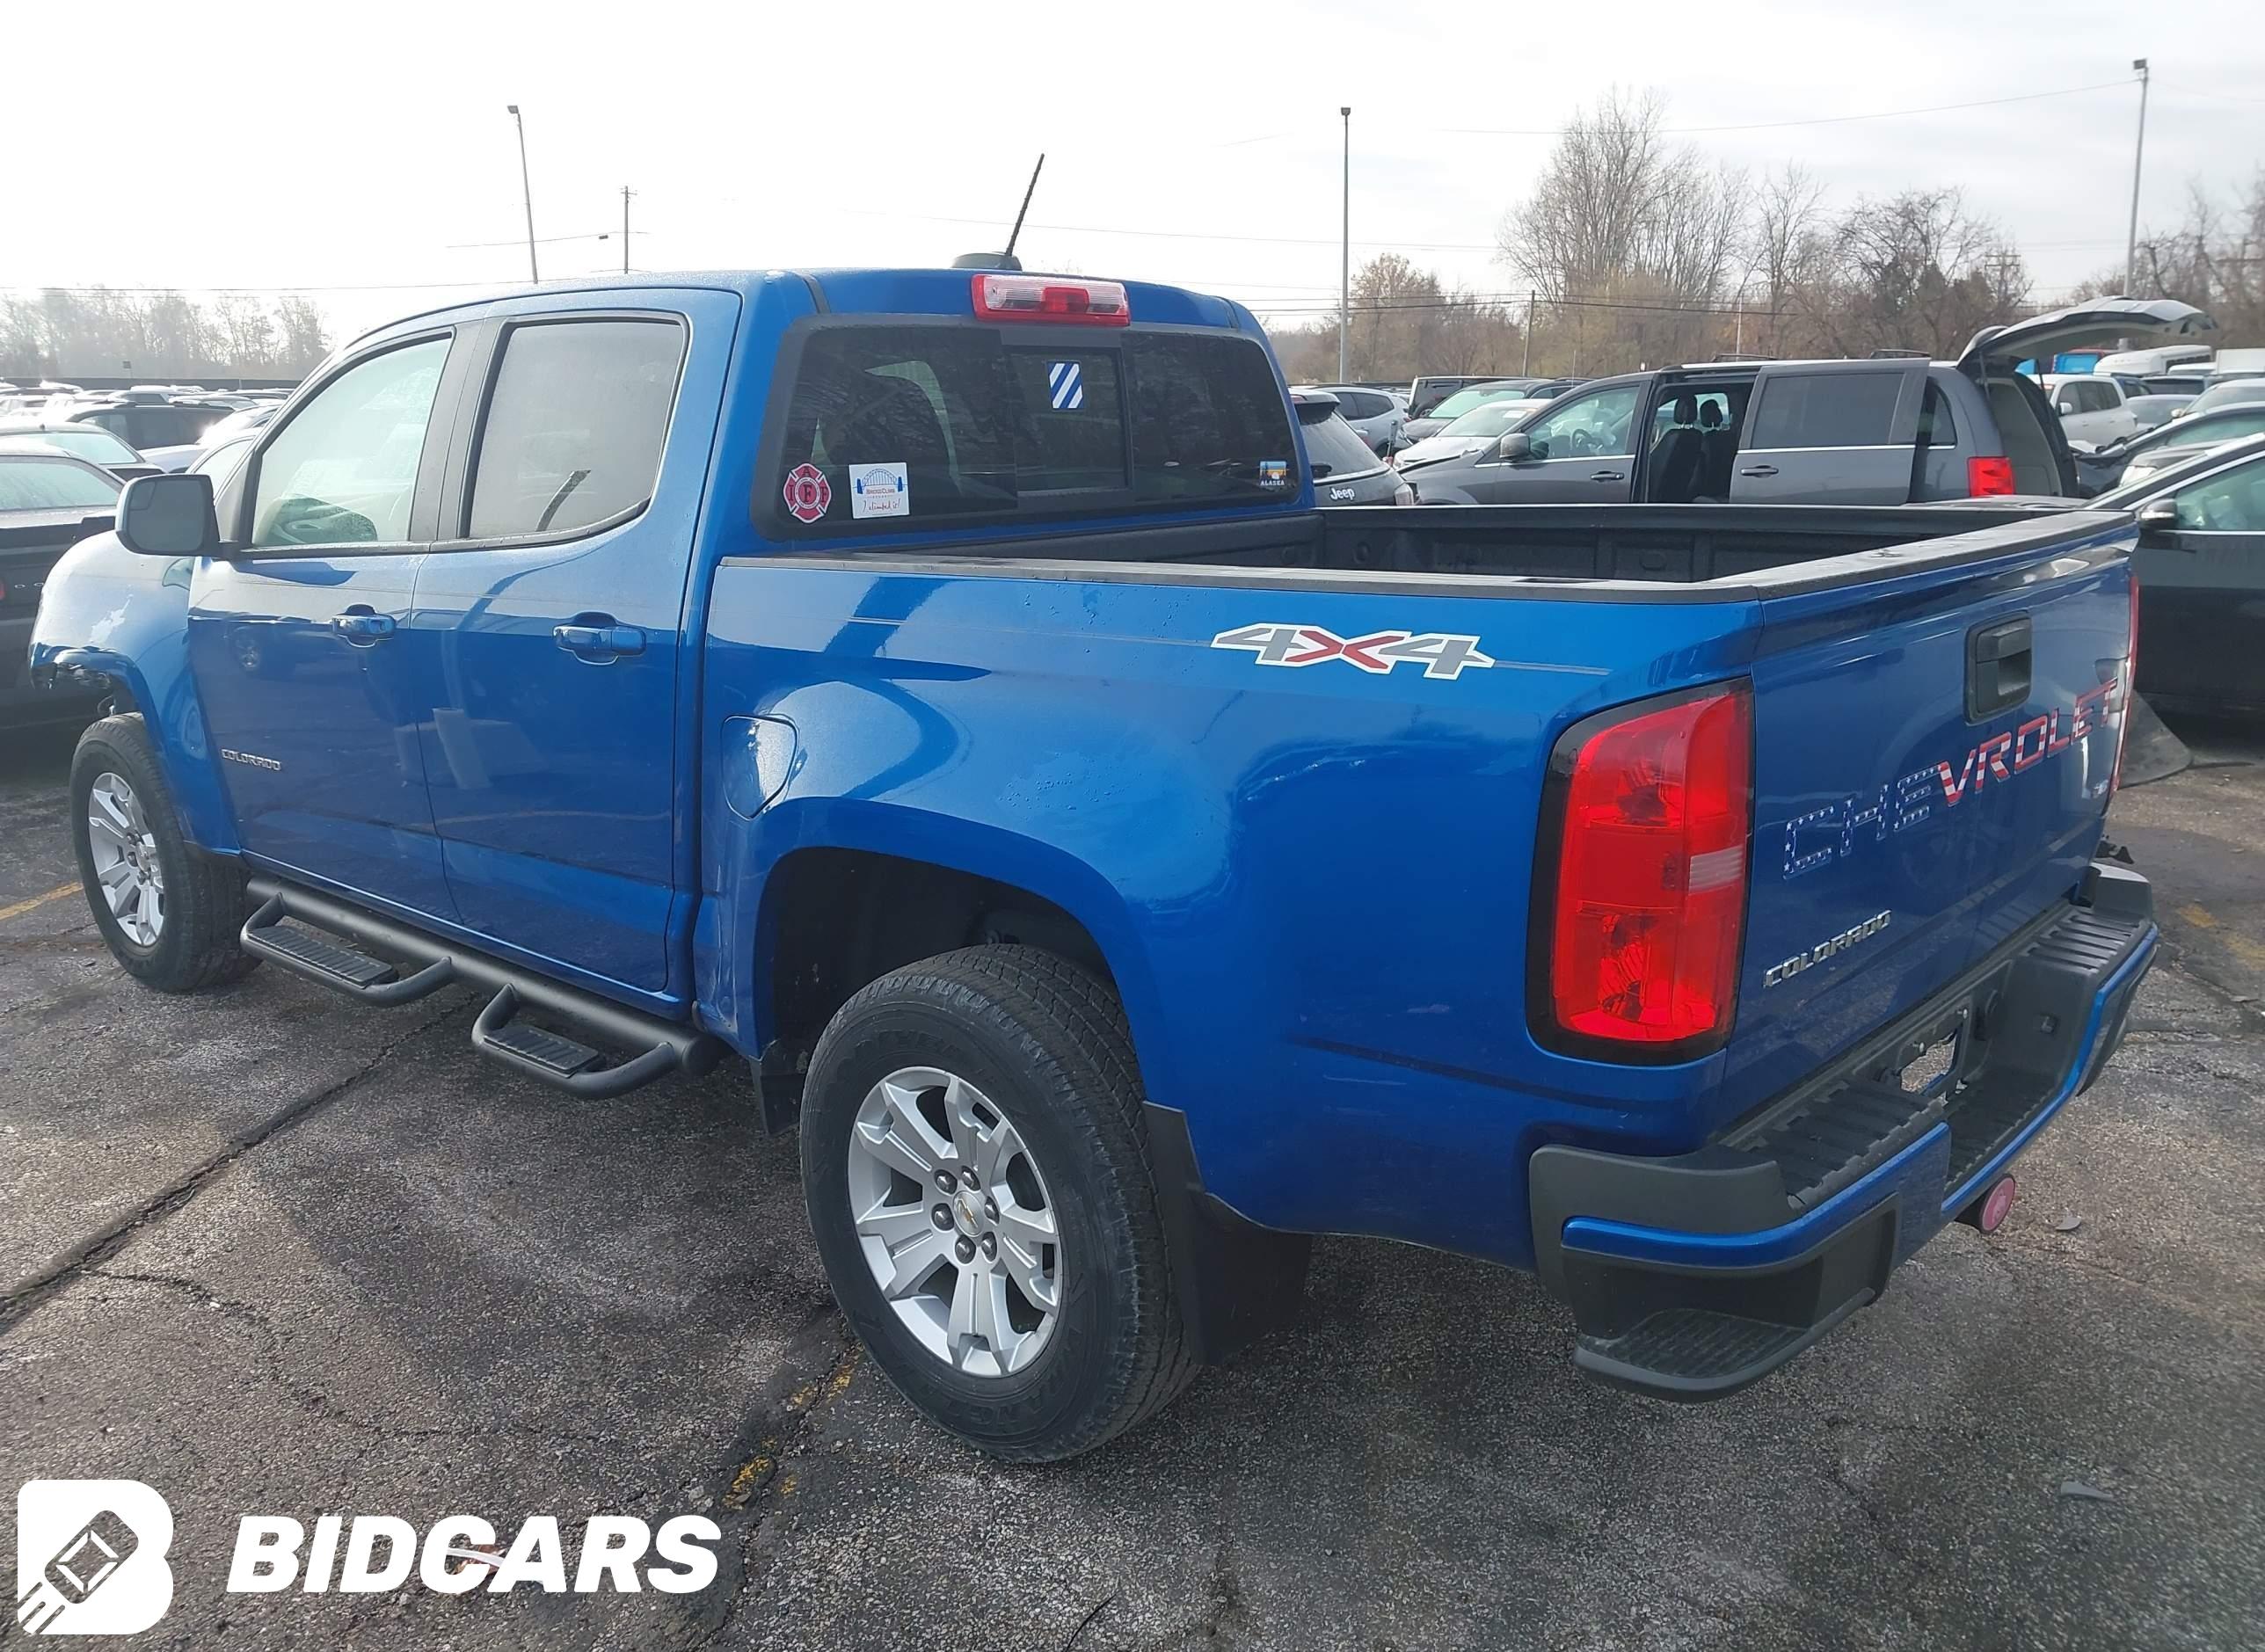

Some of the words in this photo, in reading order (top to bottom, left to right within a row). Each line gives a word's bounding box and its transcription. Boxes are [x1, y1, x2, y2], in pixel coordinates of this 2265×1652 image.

[1329, 487, 1355, 500] Jeep
[222, 749, 281, 770] COLORADO
[1783, 678, 2118, 879] CHEVROLET
[1763, 909, 1892, 989] COLORADO
